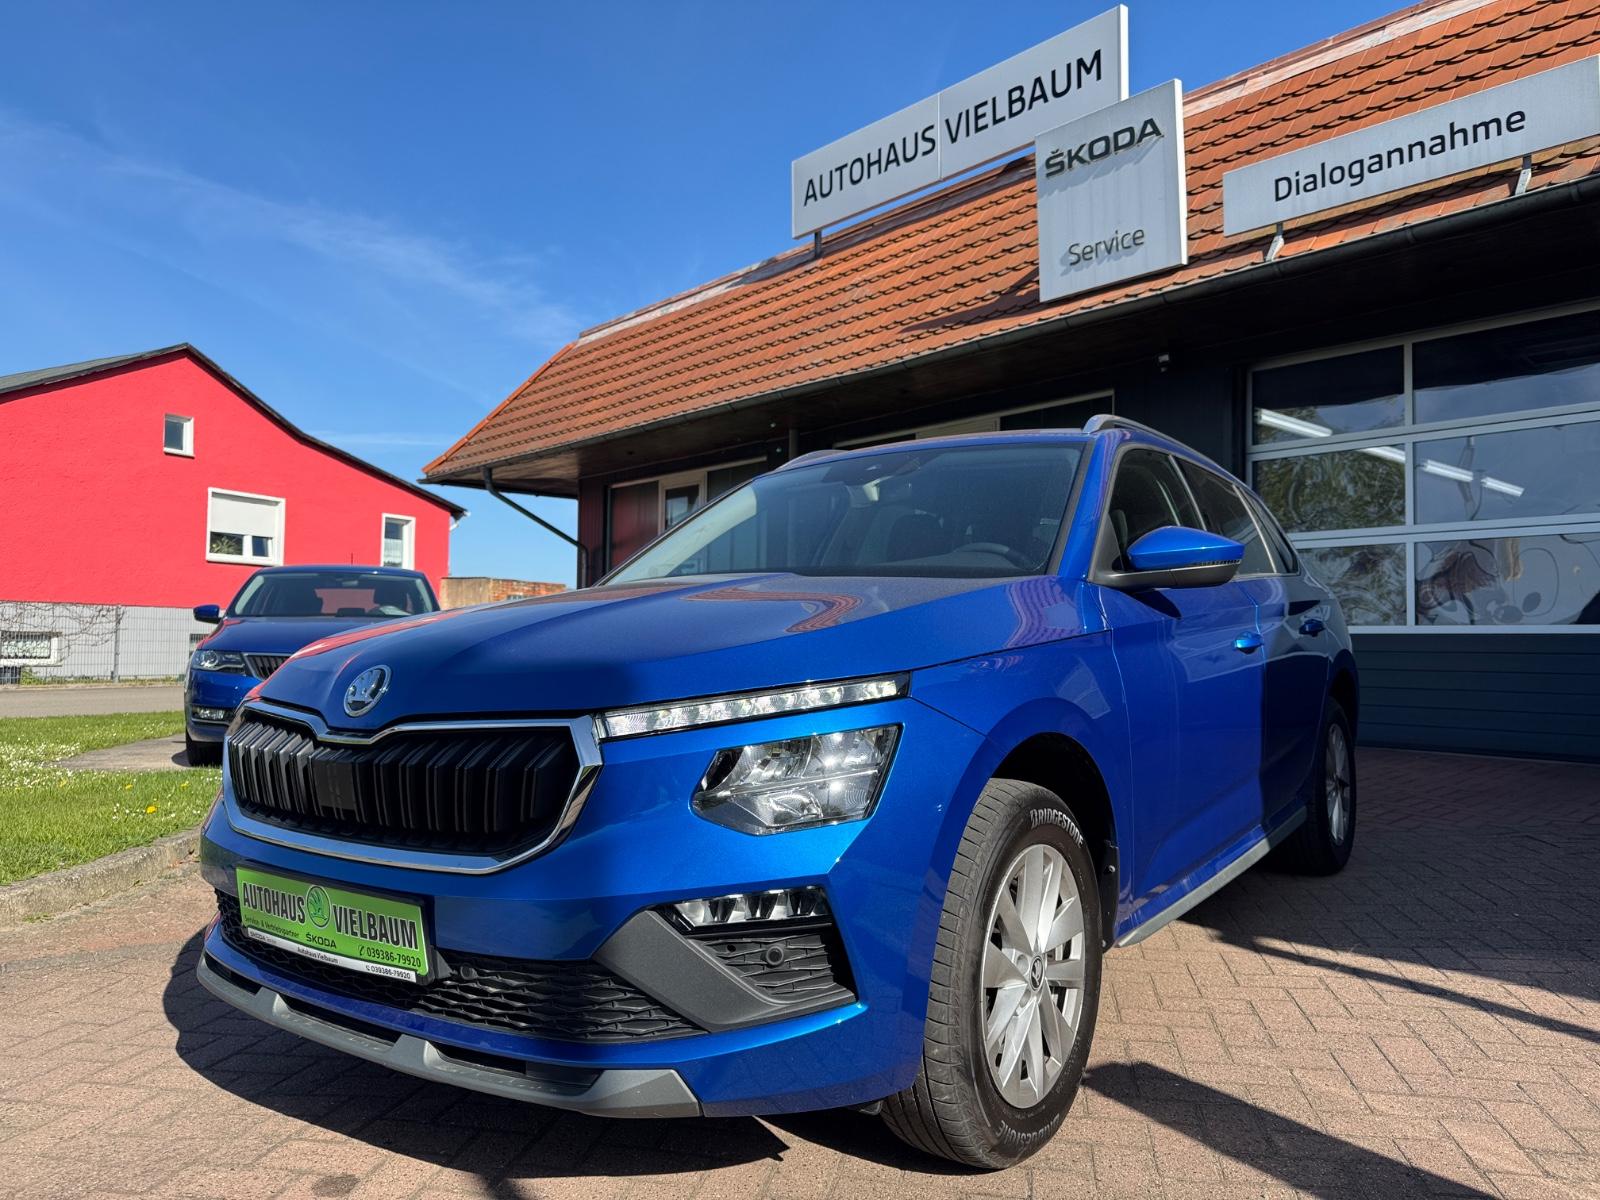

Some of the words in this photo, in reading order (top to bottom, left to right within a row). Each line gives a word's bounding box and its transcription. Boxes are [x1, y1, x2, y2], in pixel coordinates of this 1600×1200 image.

[803, 124, 936, 207] AUTOHAUS
[945, 49, 1102, 144] VIELBAUM
[1045, 118, 1163, 178] ŠKODA
[1274, 110, 1526, 202] Dialogannahme
[1068, 229, 1145, 266] Service
[1029, 807, 1084, 848] BRIDGESTONE
[242, 882, 306, 925] AUTOHAUS
[333, 904, 419, 950] VIELBAUM
[305, 932, 337, 949] ŠKODA
[366, 946, 422, 968] 039386-79920
[370, 964, 412, 980] 039386-79920
